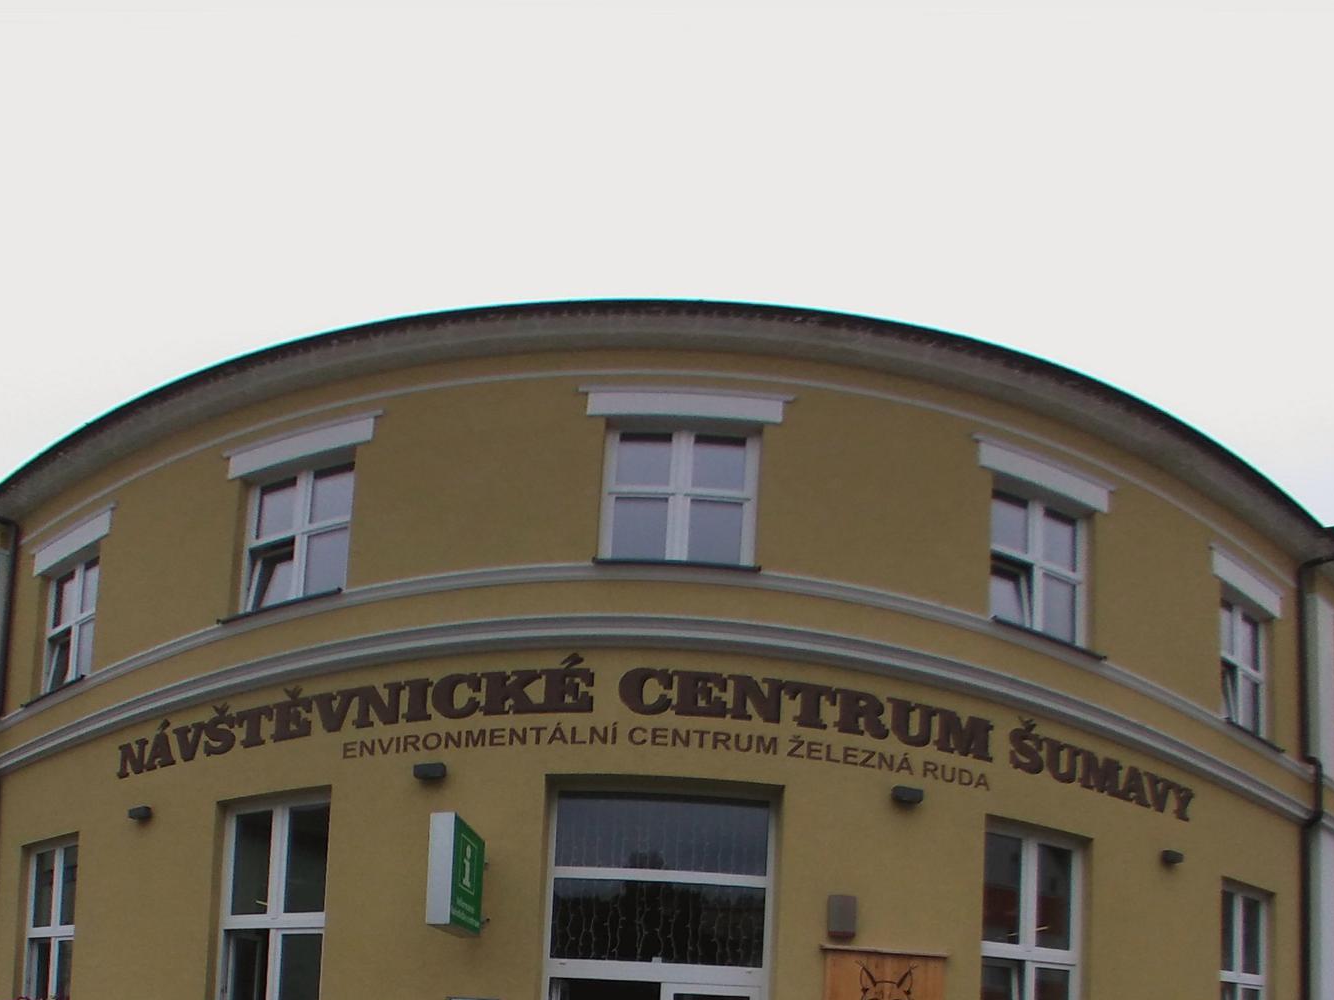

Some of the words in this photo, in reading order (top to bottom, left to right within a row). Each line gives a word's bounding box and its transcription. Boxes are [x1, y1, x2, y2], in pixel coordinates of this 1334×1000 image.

[117, 653, 595, 779] NÁVŠTĚVNICKÉ
[618, 667, 994, 762] CENTRUM
[1008, 716, 1195, 822] ŠUMAVY
[342, 721, 618, 759] ENVIRONMENTÁLNÍ
[627, 726, 778, 757] CENTRUM
[786, 734, 914, 775] ŽELEZNÁ
[922, 760, 991, 790] RUDA
